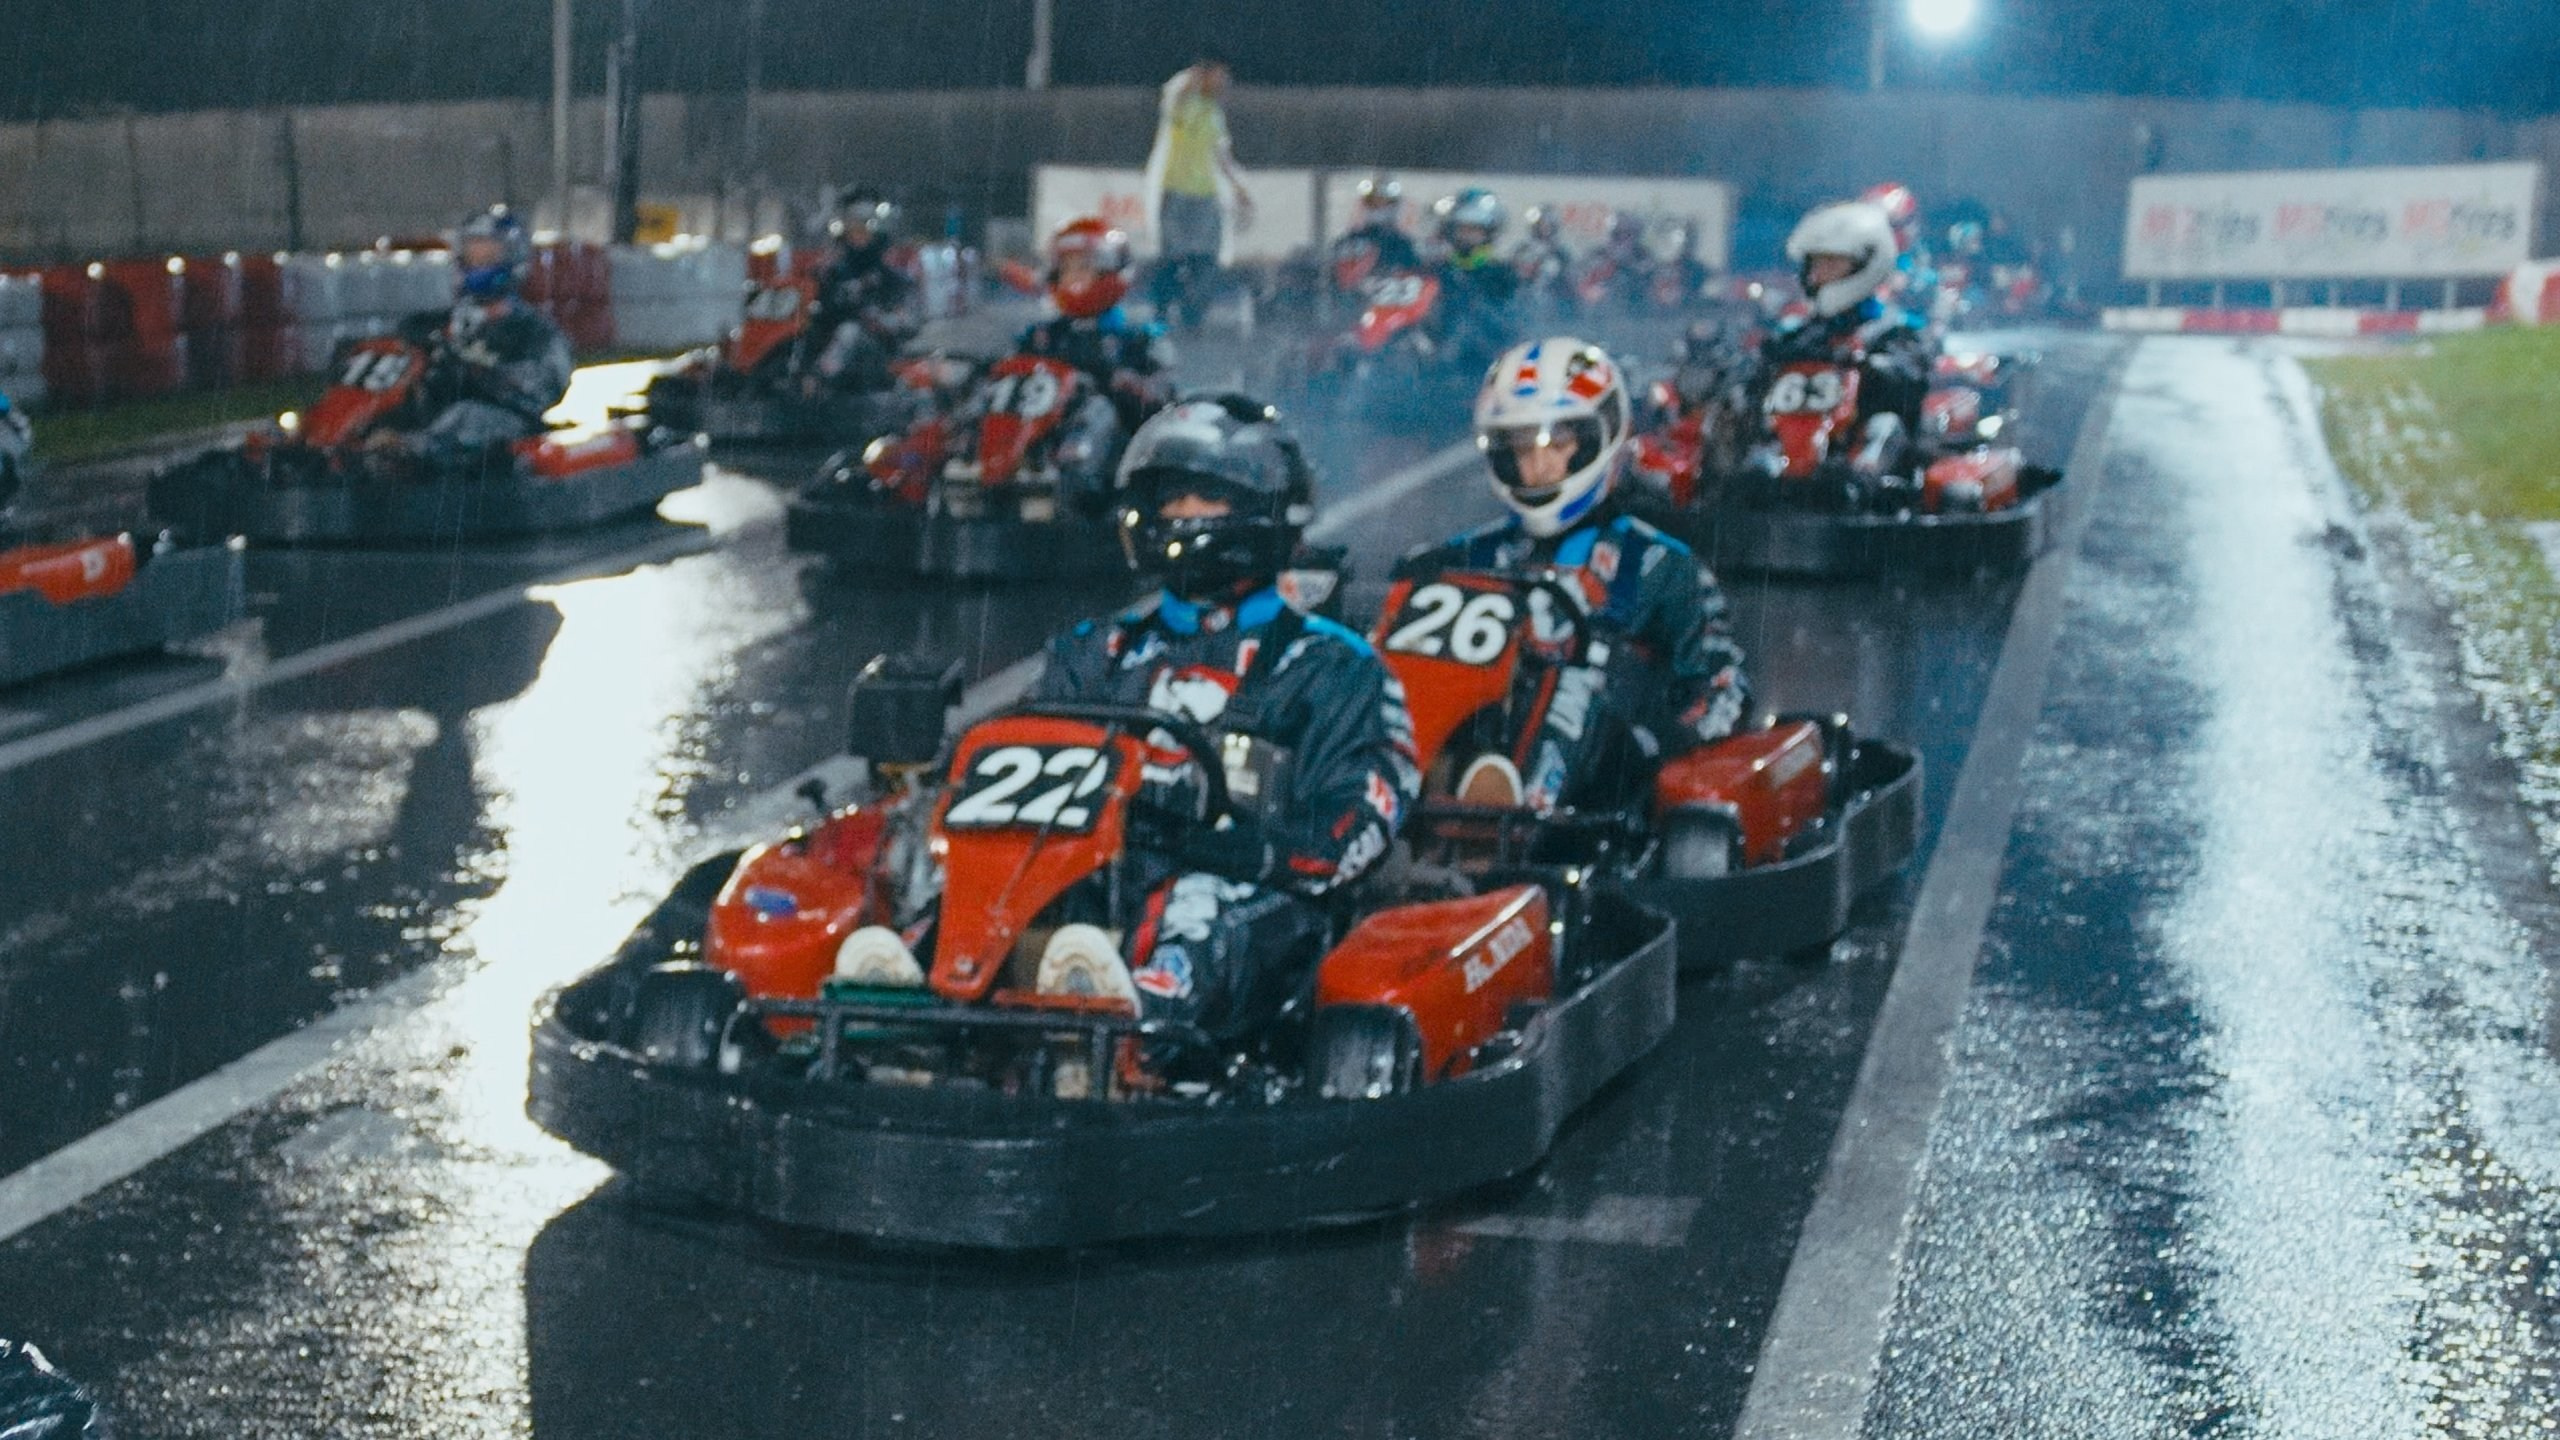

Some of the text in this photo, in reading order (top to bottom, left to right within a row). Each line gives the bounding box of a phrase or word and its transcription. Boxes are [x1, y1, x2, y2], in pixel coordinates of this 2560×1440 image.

[1769, 371, 1842, 413] 63
[1385, 583, 1514, 664] 26
[945, 746, 1109, 828] 22
